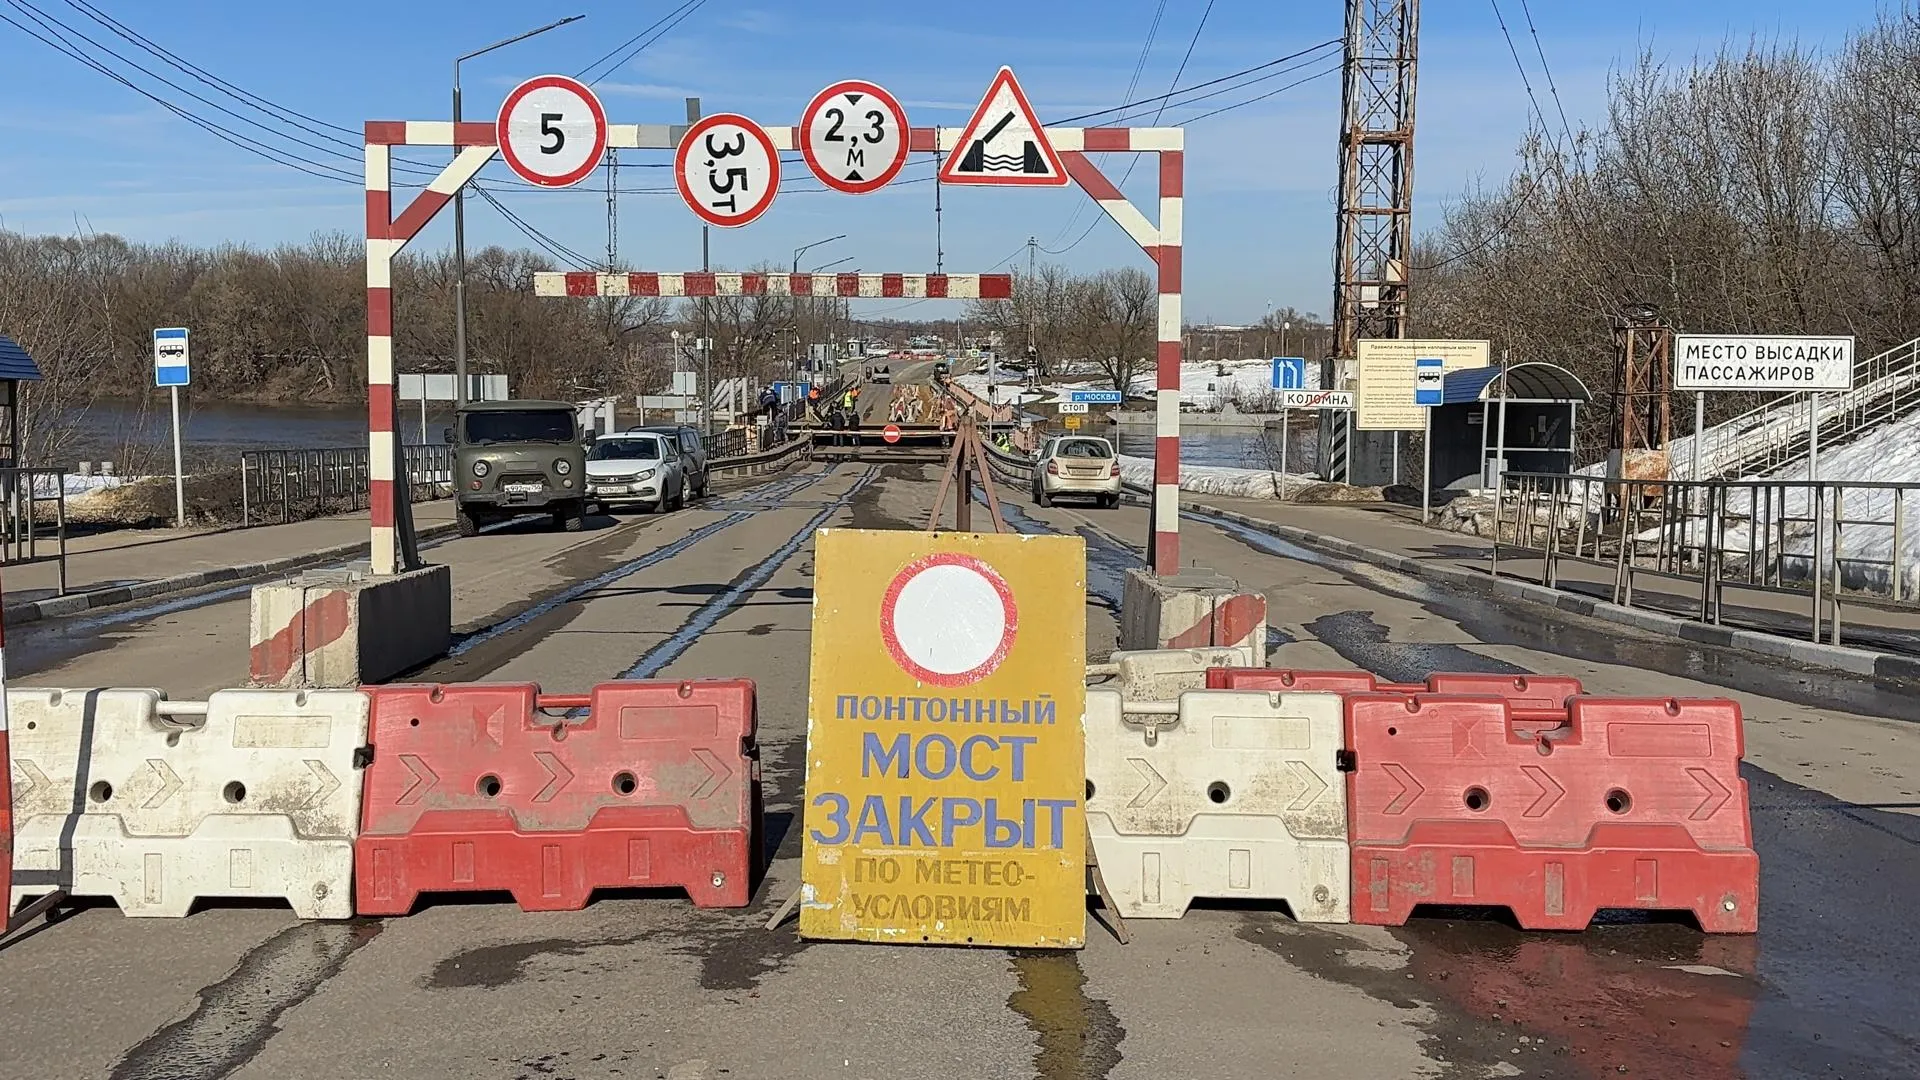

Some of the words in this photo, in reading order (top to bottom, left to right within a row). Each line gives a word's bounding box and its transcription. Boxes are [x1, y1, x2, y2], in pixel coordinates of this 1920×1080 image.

[540, 113, 565, 154] 5
[824, 108, 884, 147] 2,3
[1686, 345, 1747, 360] МЕСТО
[1755, 345, 1843, 362] ВЫСАДКИ
[1685, 365, 1814, 381] ПАССАЖИРОВ
[1062, 404, 1085, 412] СТОП
[1287, 394, 1349, 405] КОЛОМНА
[835, 693, 1056, 725] ПОНТОННЫЙ
[861, 731, 1037, 782] МОСТ
[810, 792, 1077, 849] ЗАКРЫТ
[854, 857, 901, 885] ПО
[915, 858, 1036, 887] МЕТЕО-
[850, 893, 1031, 923] УСЛОВИЯМ
